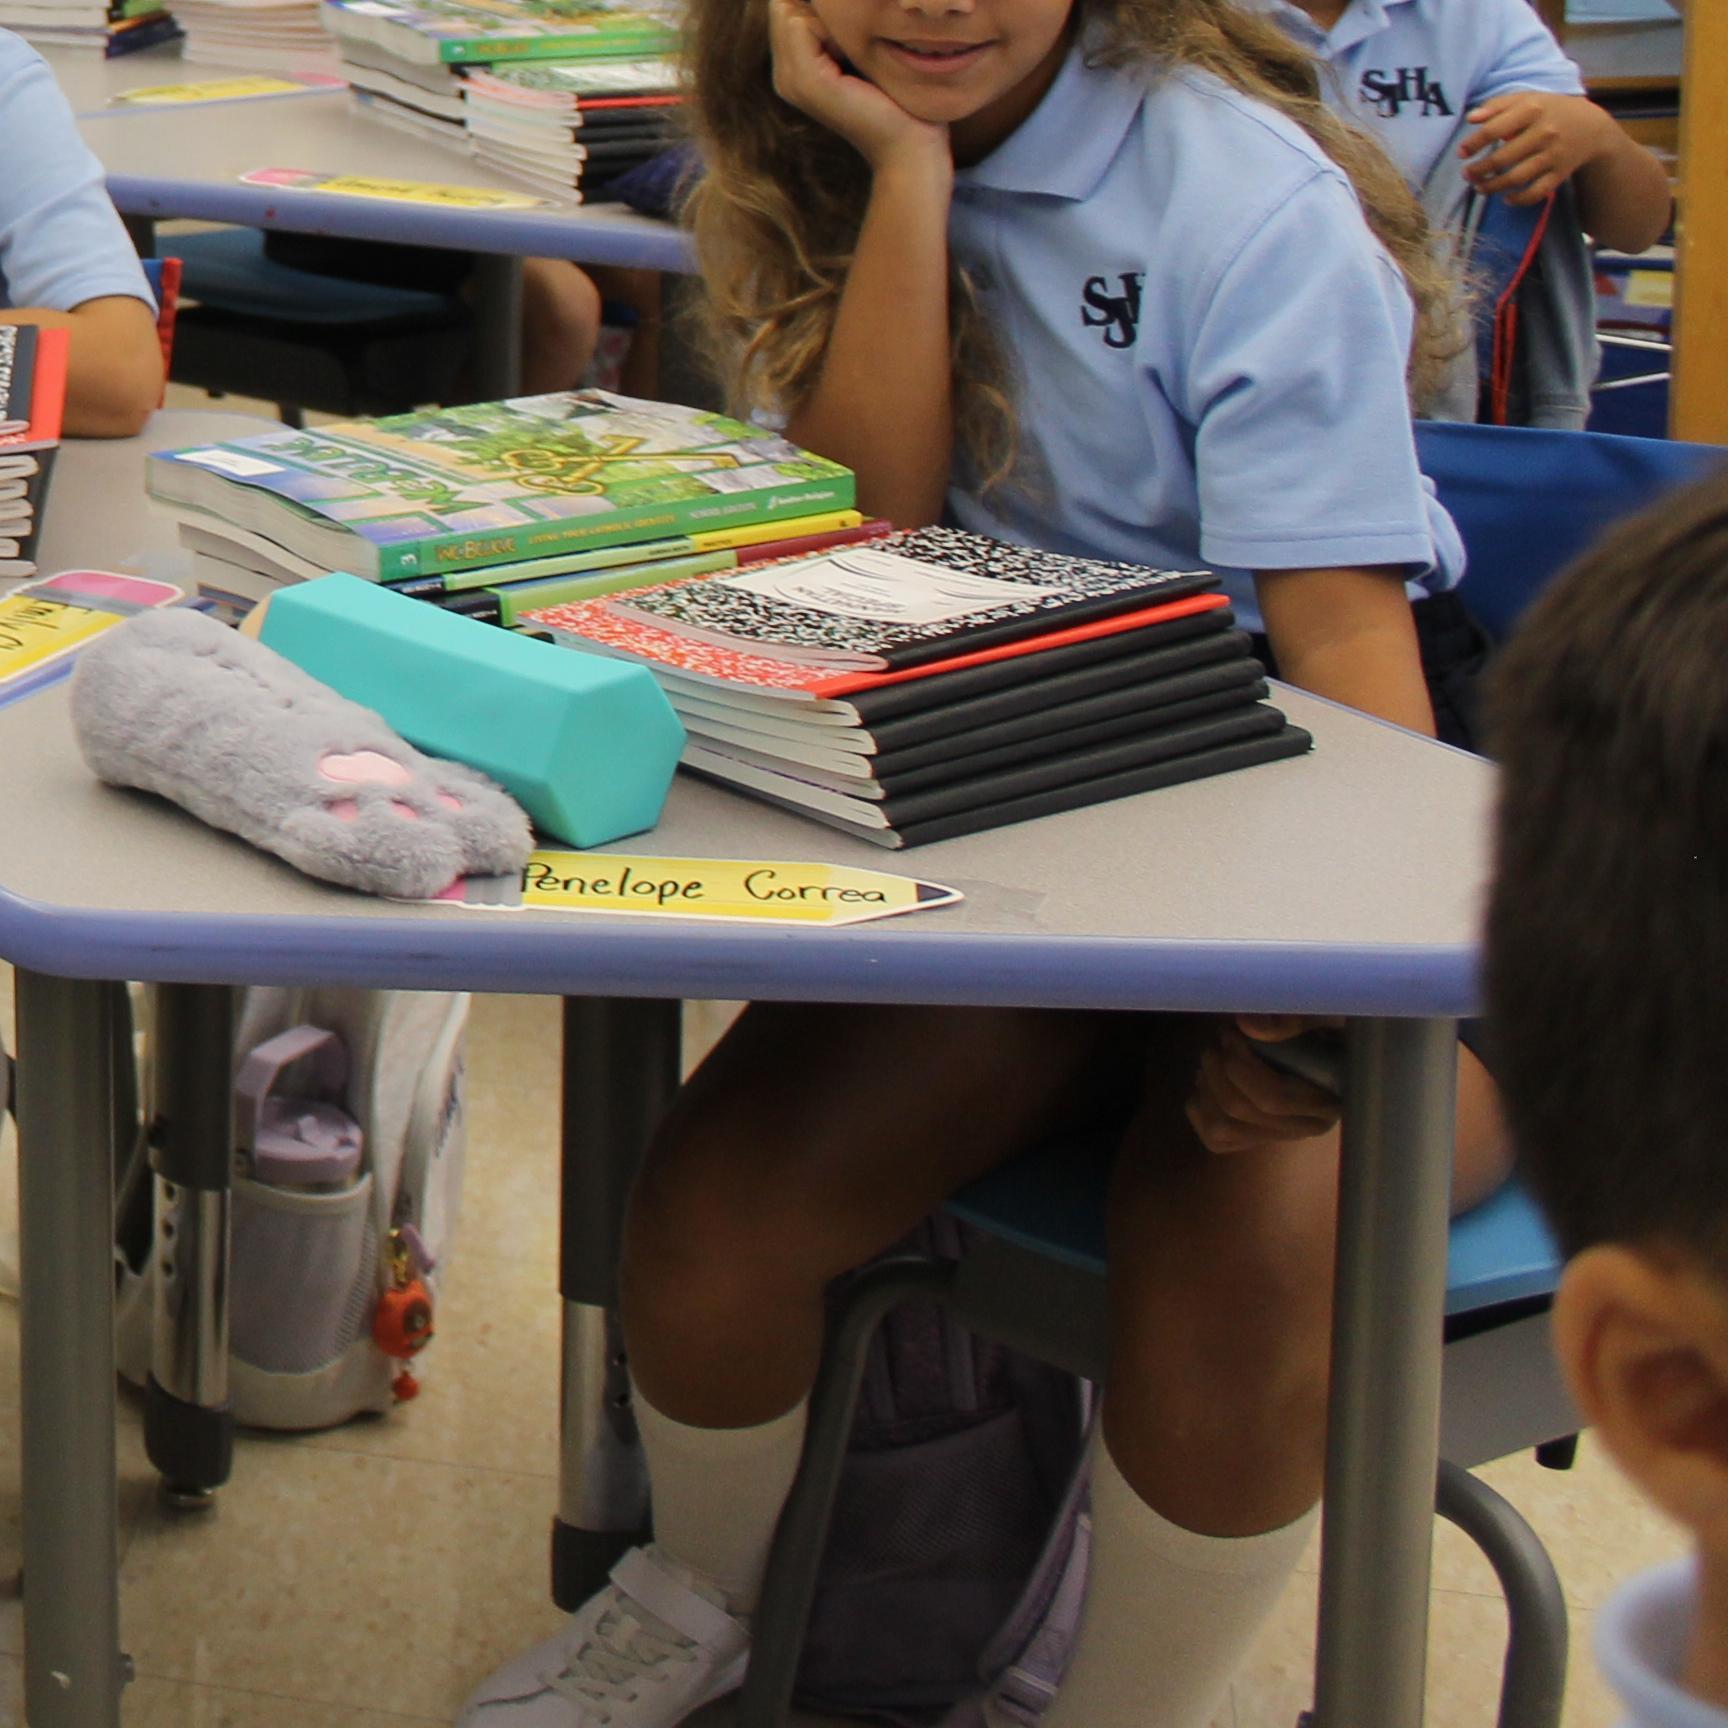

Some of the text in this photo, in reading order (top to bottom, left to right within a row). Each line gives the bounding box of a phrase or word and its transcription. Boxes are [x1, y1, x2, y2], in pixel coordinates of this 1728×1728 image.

[1359, 66, 1454, 119] SJHA
[521, 861, 888, 905] Penelope Correa
